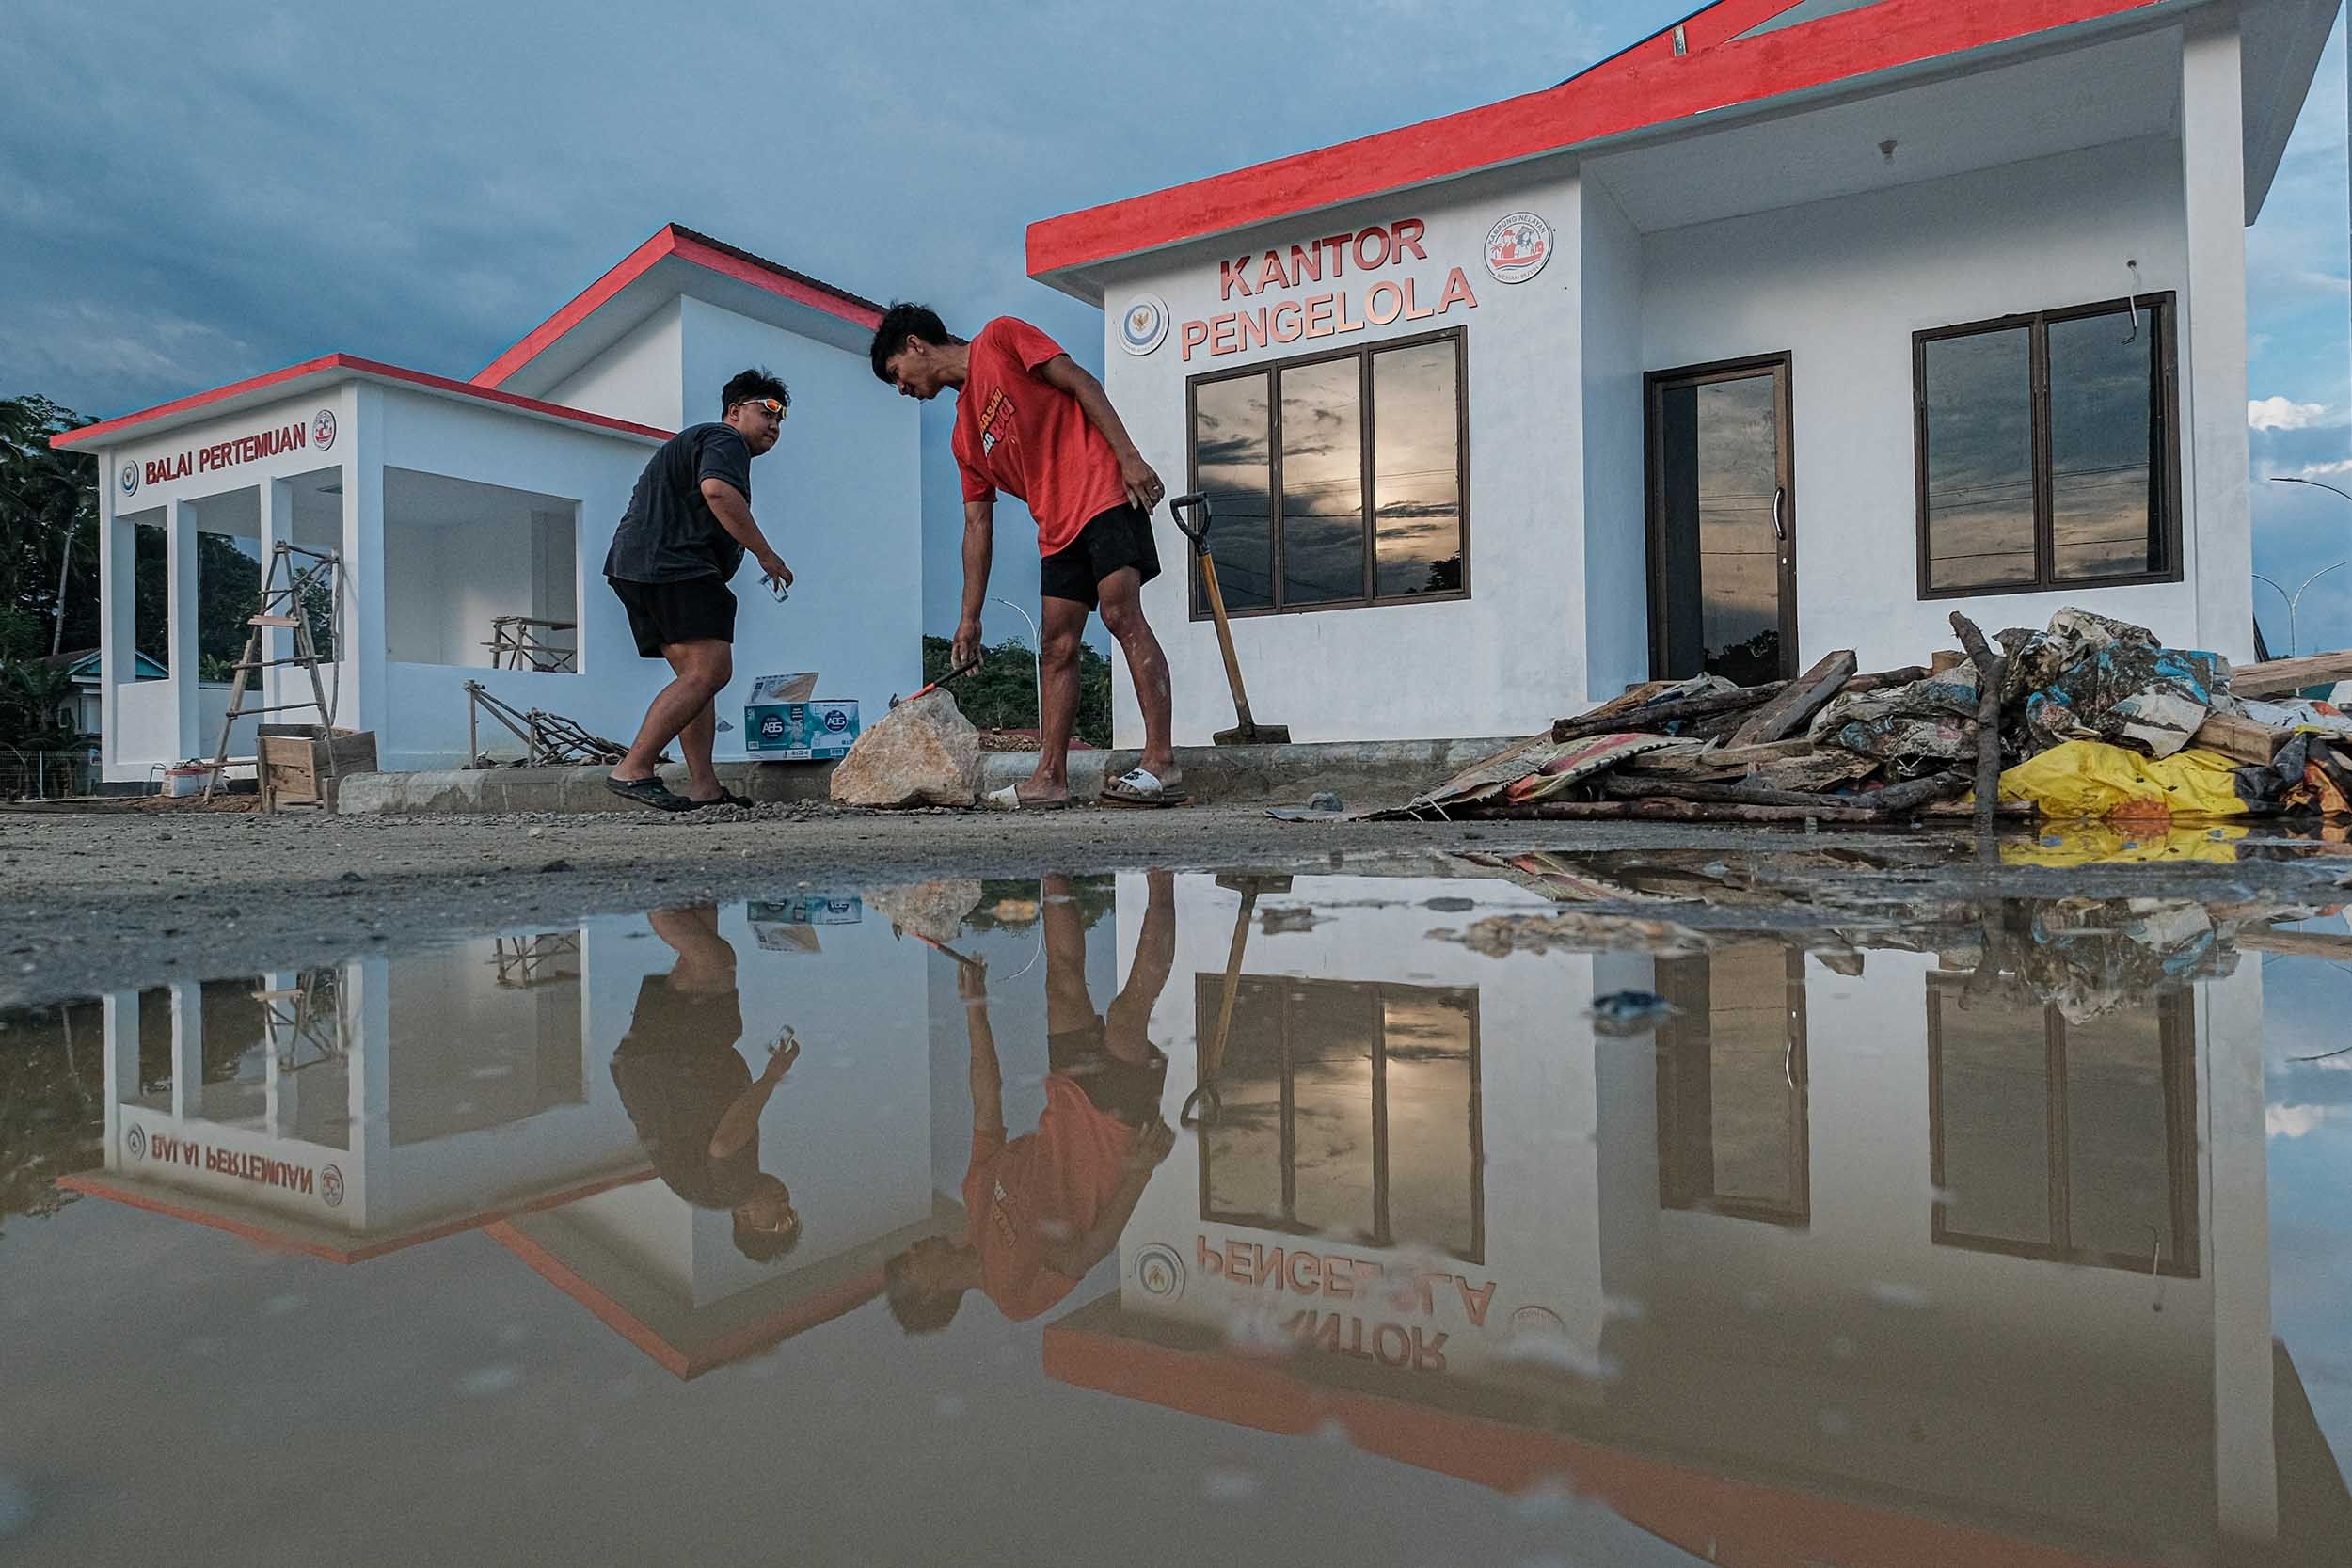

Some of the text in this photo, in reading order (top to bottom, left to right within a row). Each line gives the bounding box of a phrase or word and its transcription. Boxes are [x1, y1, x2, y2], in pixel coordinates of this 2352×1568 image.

[1220, 218, 1426, 301] KANTOR
[1488, 215, 1547, 245] KAMPUNG NELAYAN
[1181, 267, 1476, 361] PENGELOLA
[146, 422, 306, 485] BALAI PERTEMUAN
